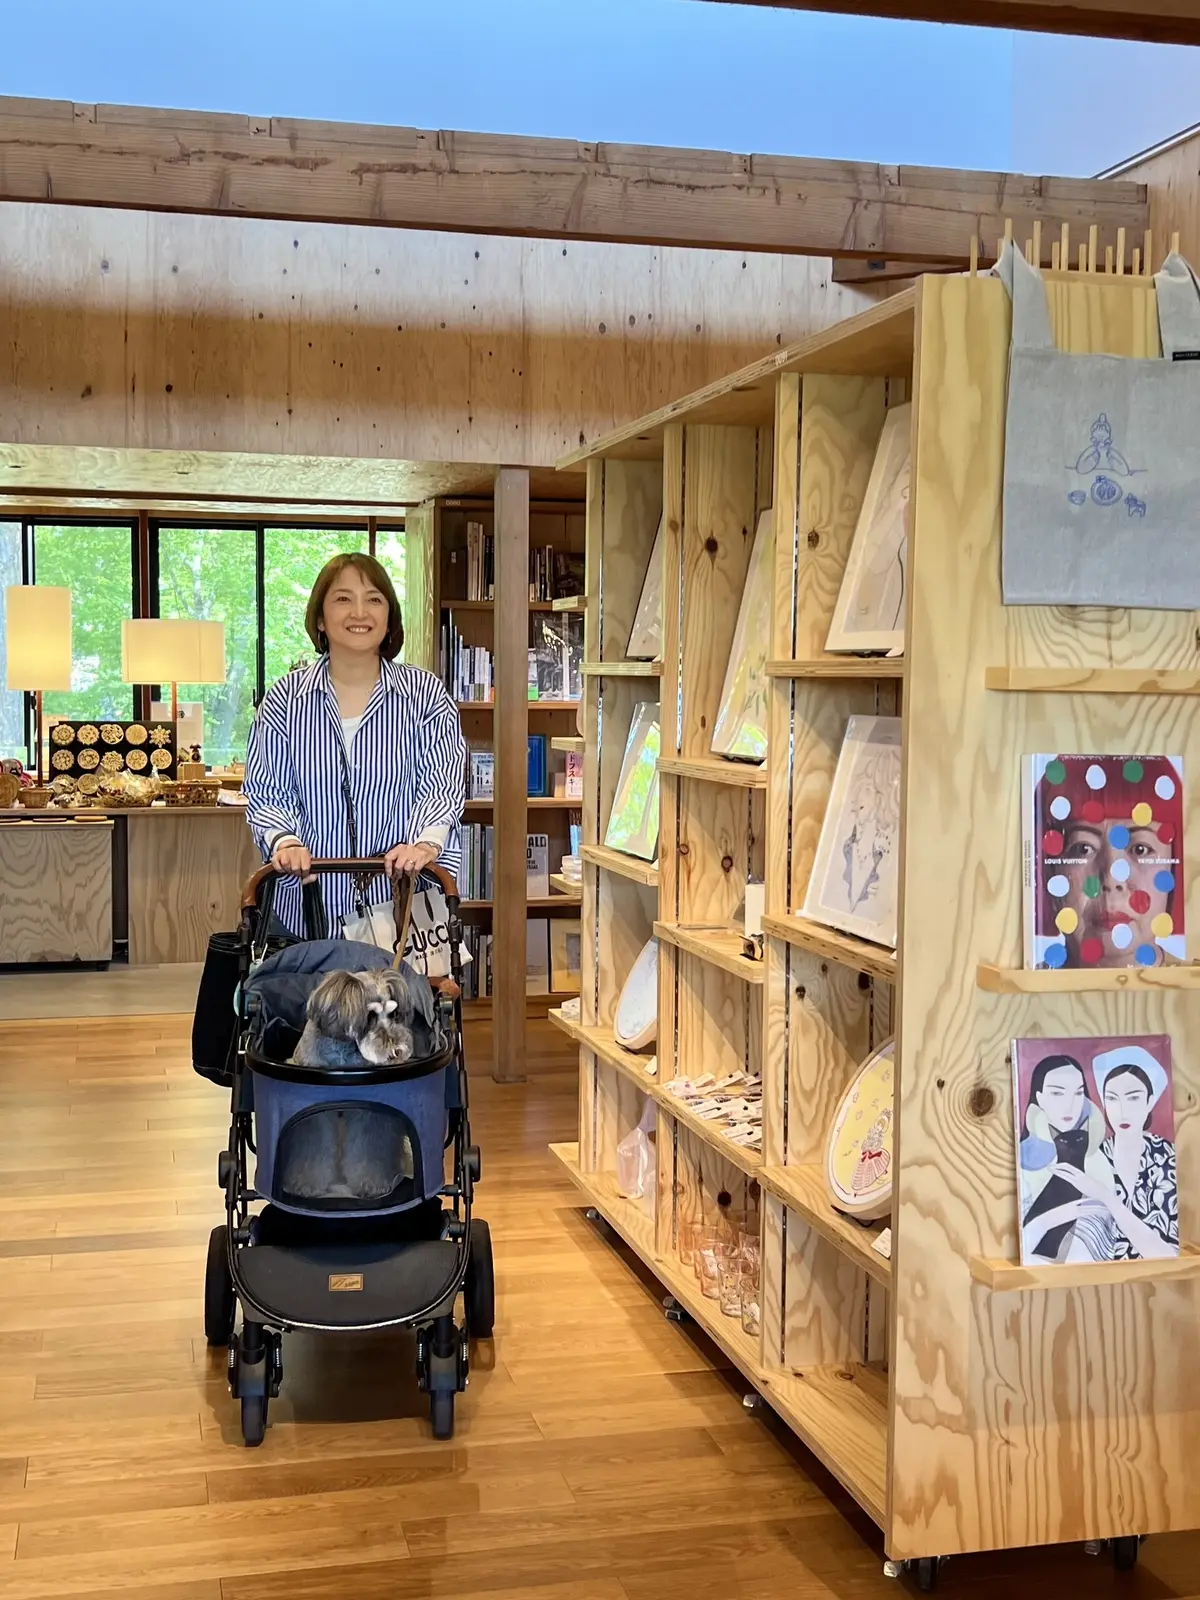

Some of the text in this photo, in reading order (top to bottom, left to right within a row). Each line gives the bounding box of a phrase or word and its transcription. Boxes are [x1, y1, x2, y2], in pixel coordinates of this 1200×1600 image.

[568, 750, 576, 793] ドフスキー
[392, 921, 450, 957] GUCC
